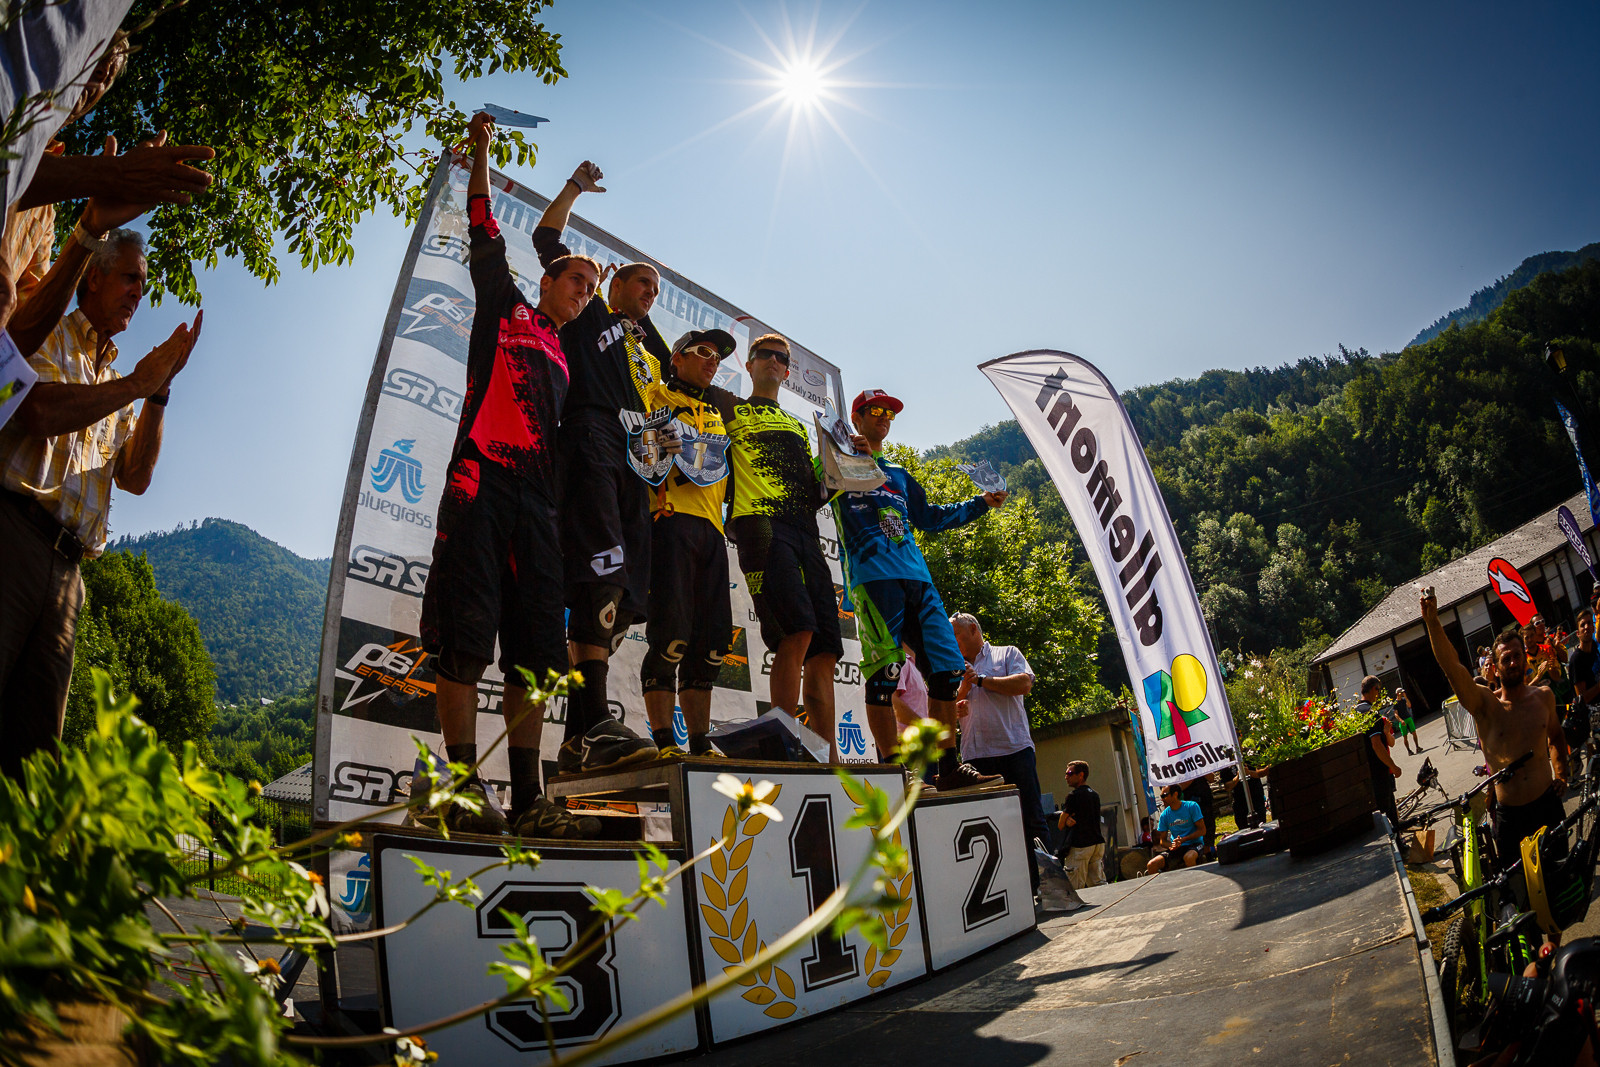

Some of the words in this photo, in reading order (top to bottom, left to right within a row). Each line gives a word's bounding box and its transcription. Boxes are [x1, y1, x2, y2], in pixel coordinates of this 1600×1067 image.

[792, 382, 807, 398] July
[356, 664, 430, 698] ENERGY
[788, 793, 860, 992] 1
[954, 816, 1010, 933] 2
[476, 881, 622, 1052] 3
